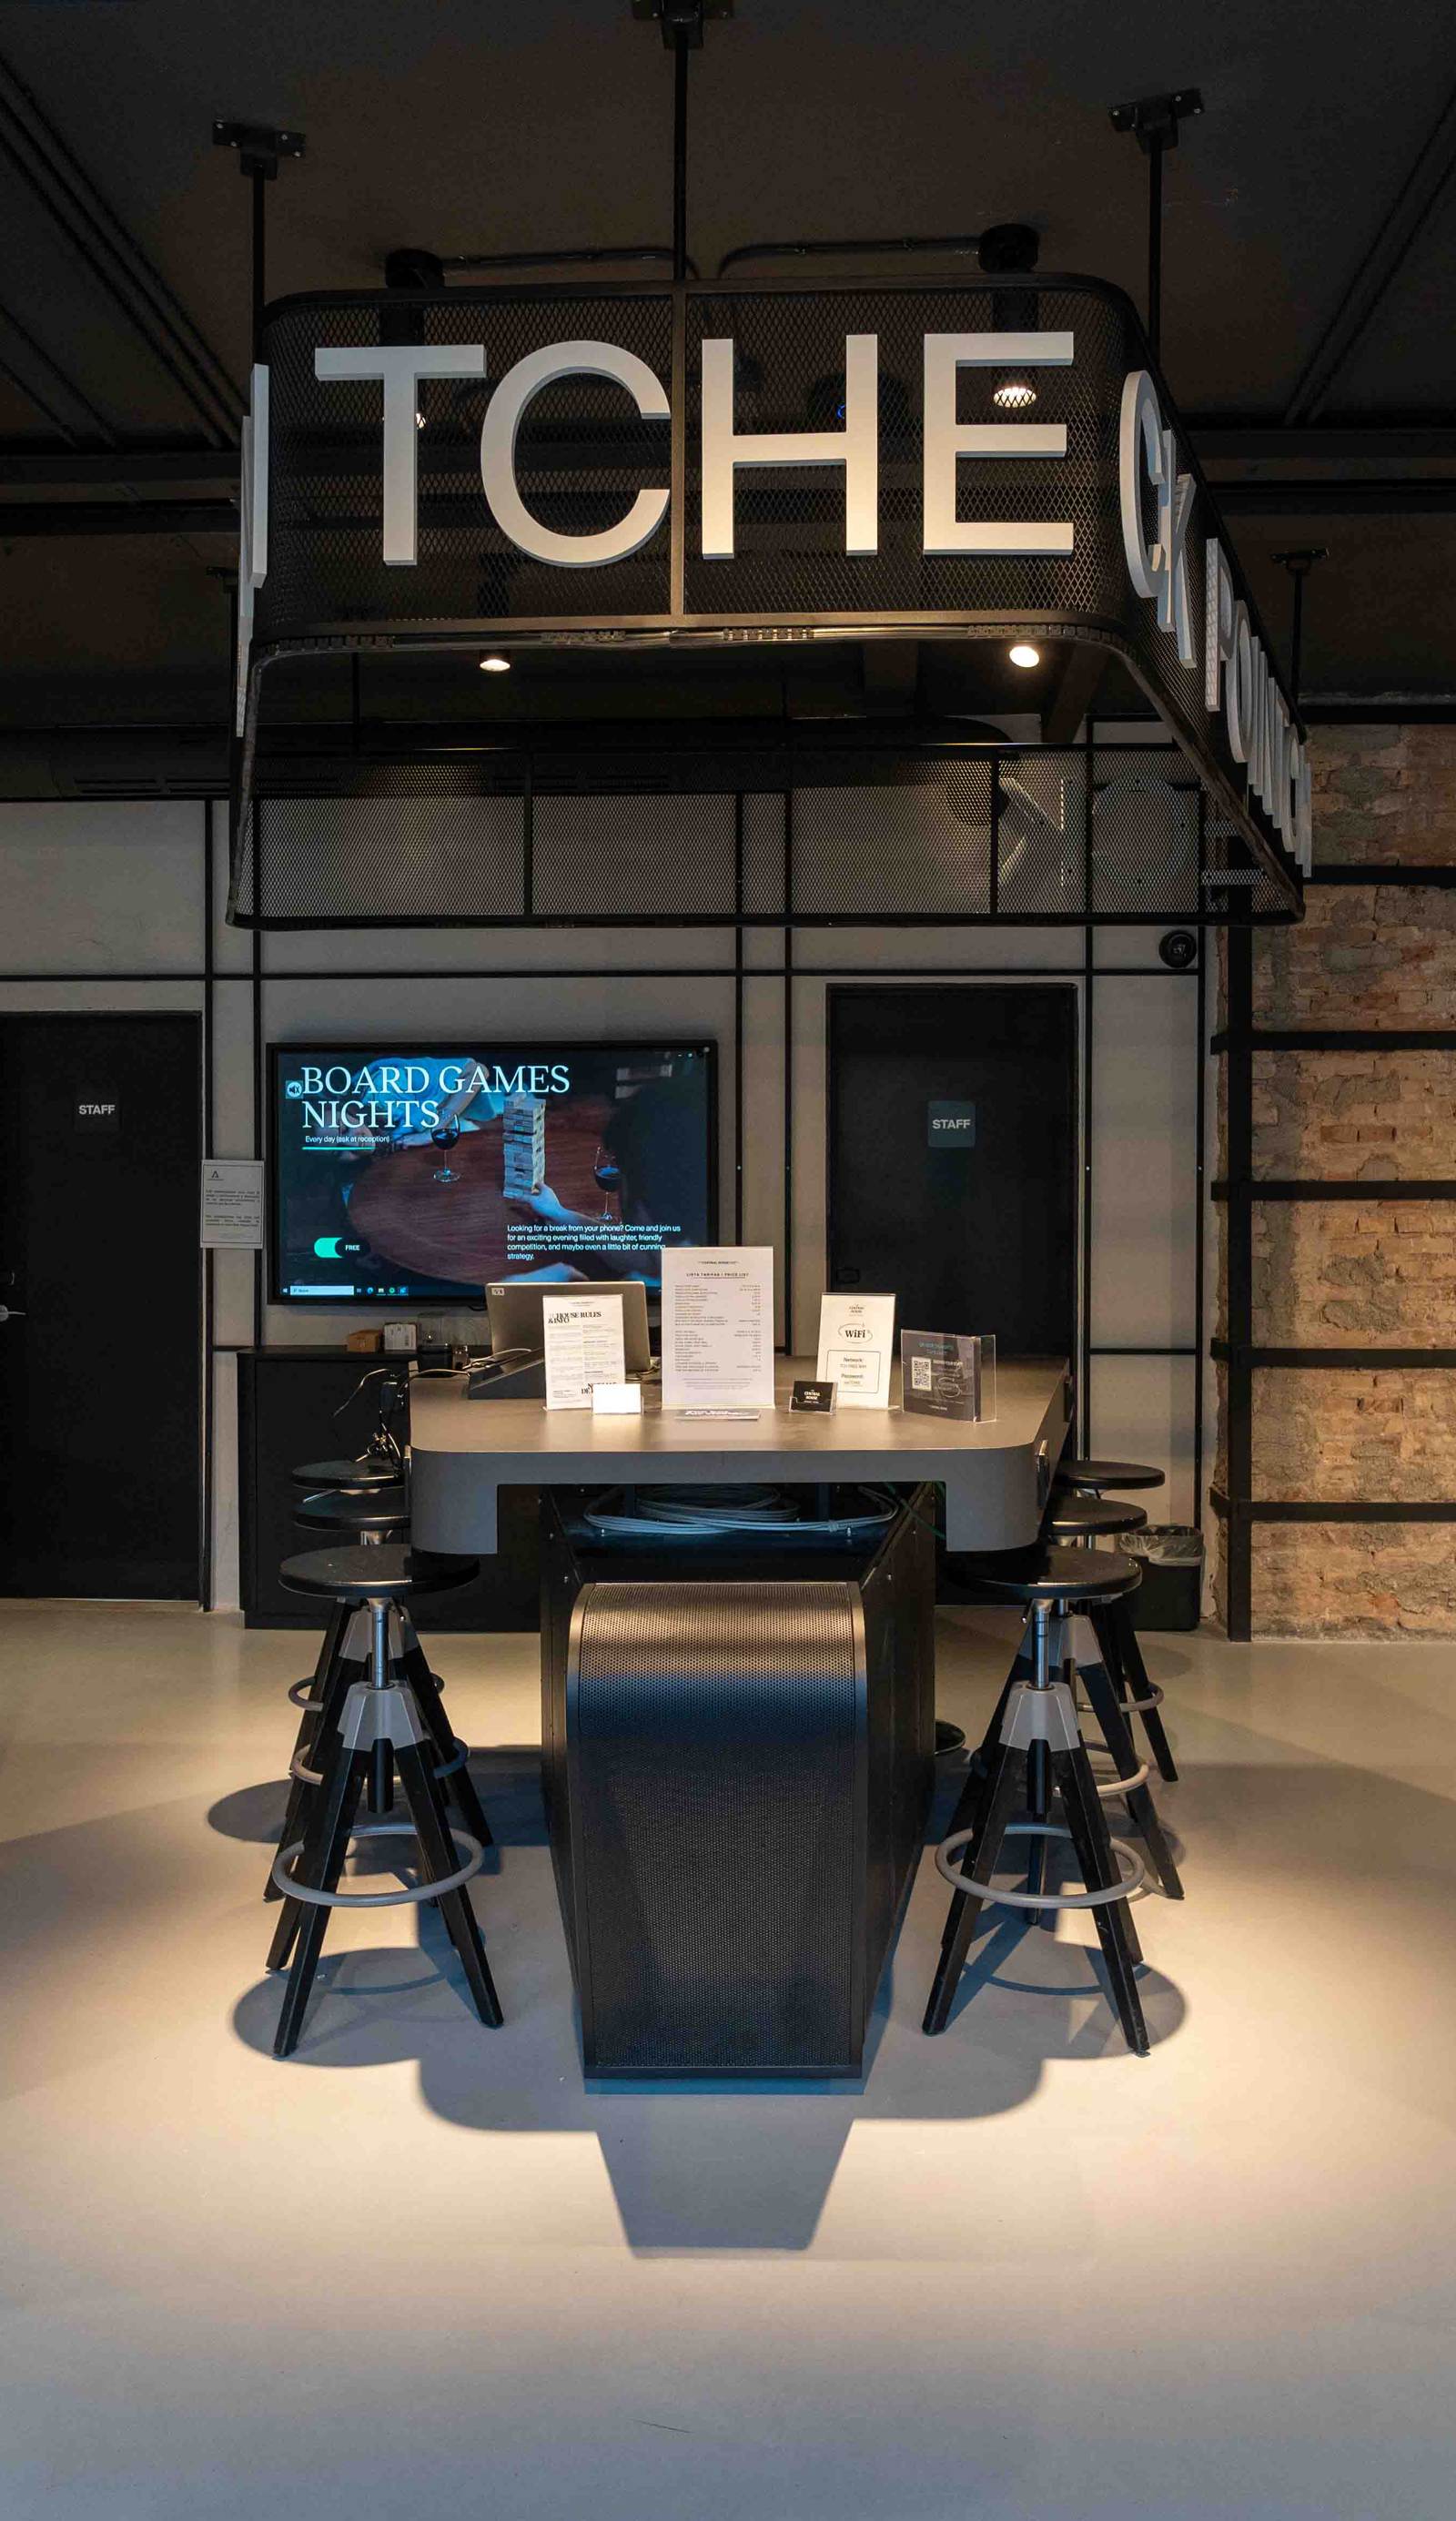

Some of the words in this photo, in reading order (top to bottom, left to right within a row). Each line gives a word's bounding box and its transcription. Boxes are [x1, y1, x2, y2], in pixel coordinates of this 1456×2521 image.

[301, 1066, 430, 1094] BOARD
[439, 1065, 571, 1094] GAMES
[78, 1104, 116, 1115] STAFF
[302, 1100, 440, 1129] NIGHTS
[932, 1119, 971, 1129] STAFF
[305, 1135, 323, 1144] Every
[323, 1135, 335, 1144] day
[336, 1135, 349, 1144] (ask
[358, 1135, 390, 1144] reception)
[507, 1224, 533, 1233] Looking
[533, 1224, 542, 1232] for
[549, 1224, 568, 1232] break
[568, 1224, 583, 1232] from
[584, 1225, 598, 1233] your
[600, 1224, 624, 1233] phone?
[624, 1224, 645, 1232] Come
[645, 1224, 659, 1232] and
[659, 1224, 672, 1233] join
[507, 1233, 516, 1241] for
[527, 1233, 551, 1243] exciting
[552, 1234, 579, 1243] evening
[579, 1233, 595, 1241] filled
[595, 1233, 610, 1241] with
[610, 1233, 638, 1243] laughter,
[638, 1233, 662, 1243] friendly
[507, 1243, 548, 1251] competition,
[561, 1243, 584, 1251] maybe
[607, 1242, 622, 1250] little
[622, 1242, 631, 1250] bit
[507, 1252, 535, 1261] strategy.
[845, 1329, 866, 1339] WiFi
